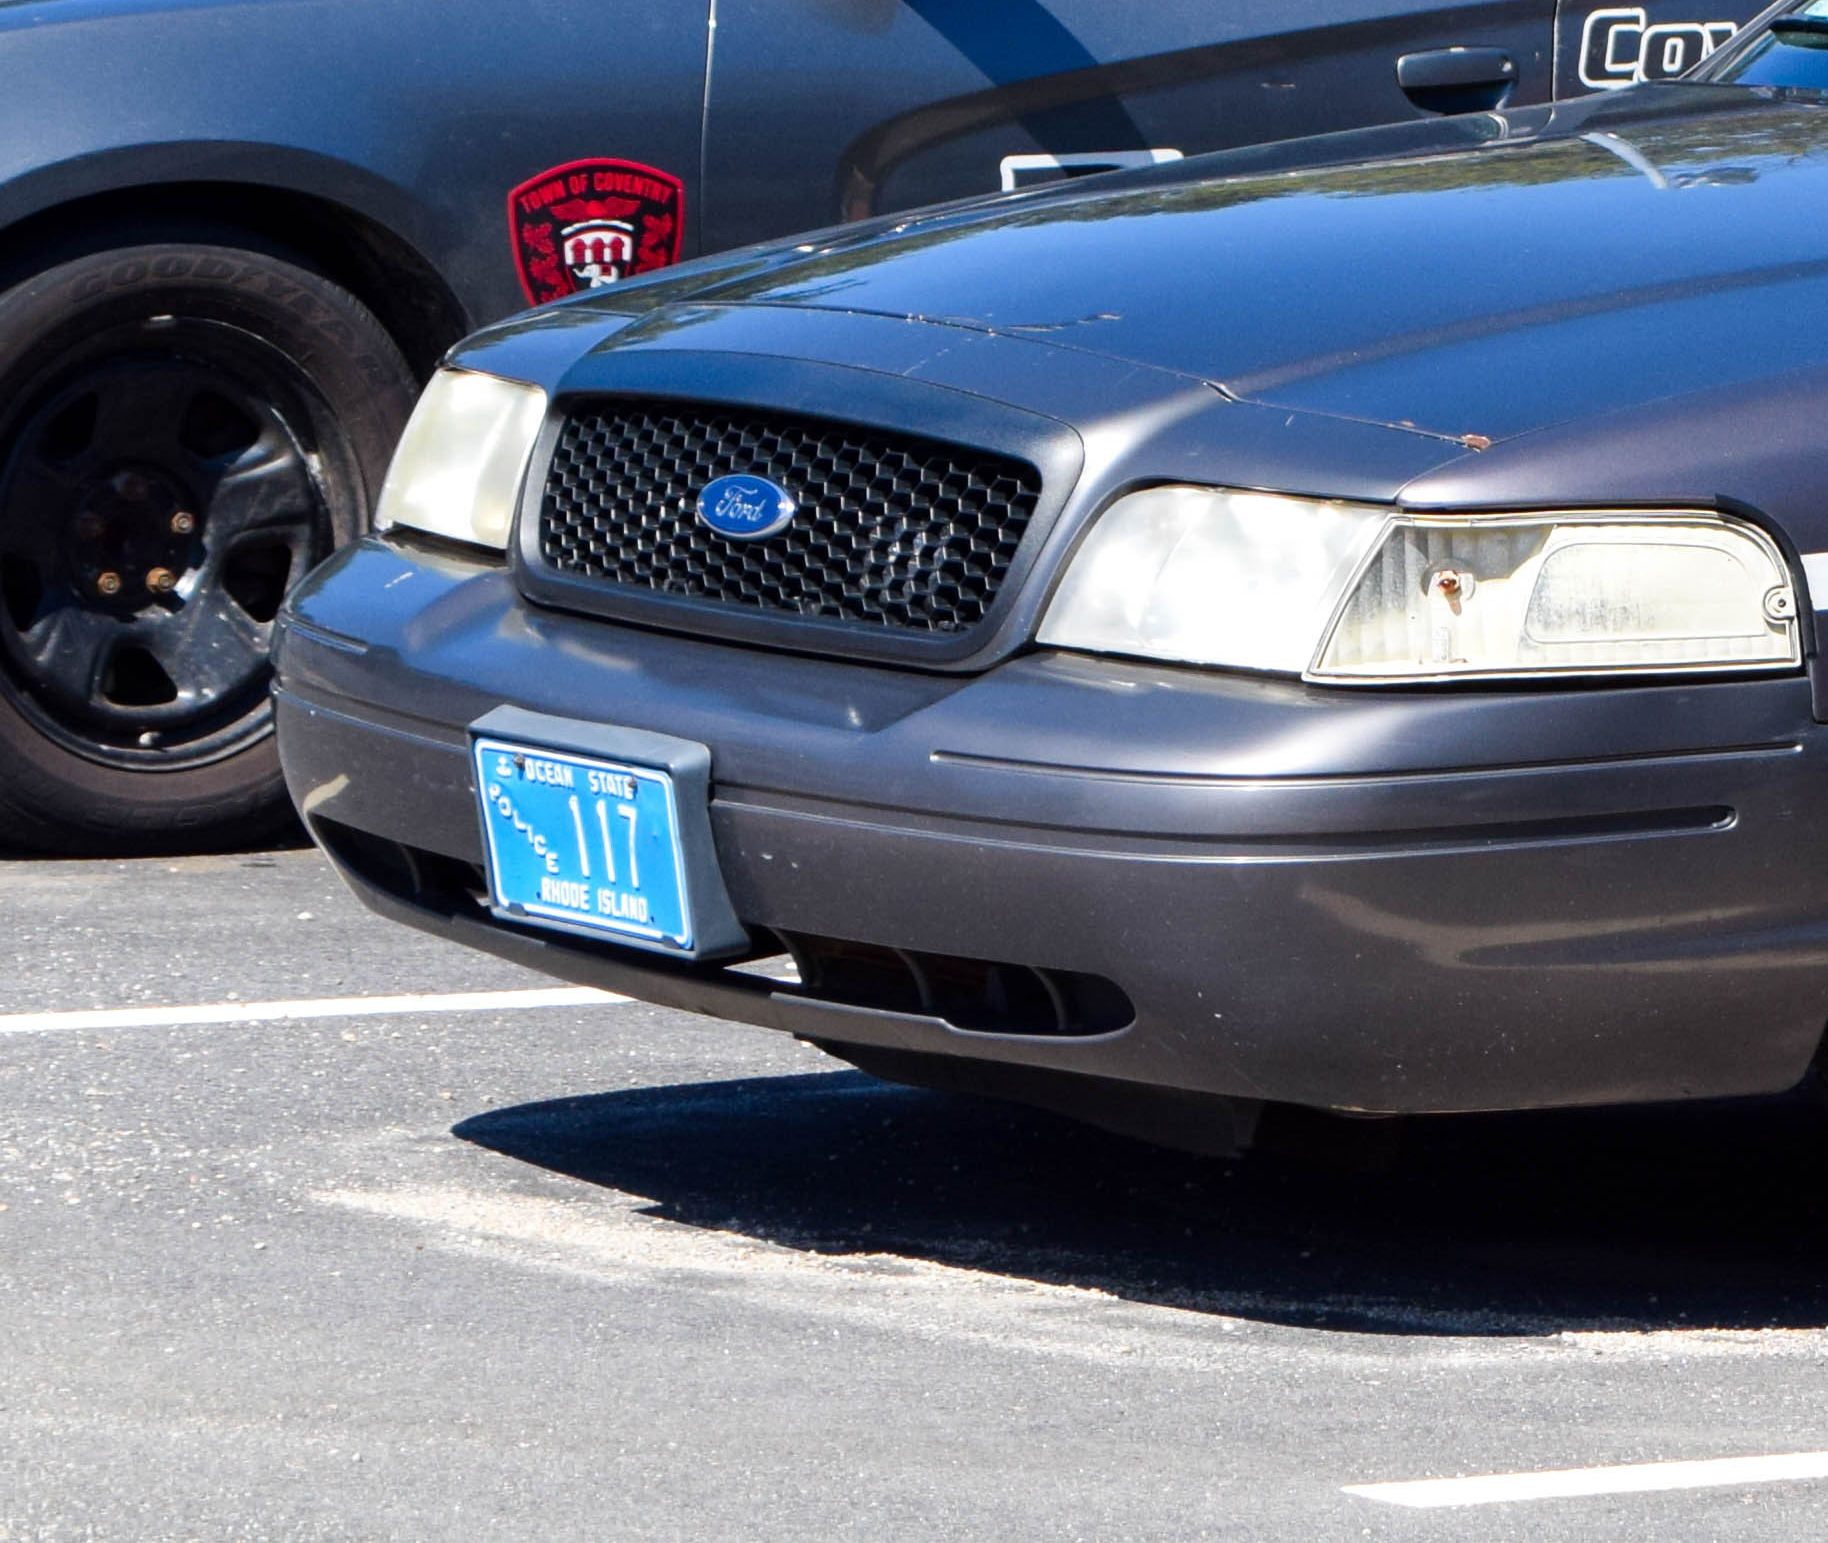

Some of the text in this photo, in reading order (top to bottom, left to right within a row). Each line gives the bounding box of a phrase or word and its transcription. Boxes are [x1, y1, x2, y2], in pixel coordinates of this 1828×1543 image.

[520, 172, 672, 213] TOWN OF COVENTRY
[715, 484, 767, 522] Ford
[524, 760, 635, 800] OCEAN STATE
[488, 782, 560, 875] POLICE
[568, 794, 641, 890] 117
[540, 876, 649, 924] RHODE ISLAND
